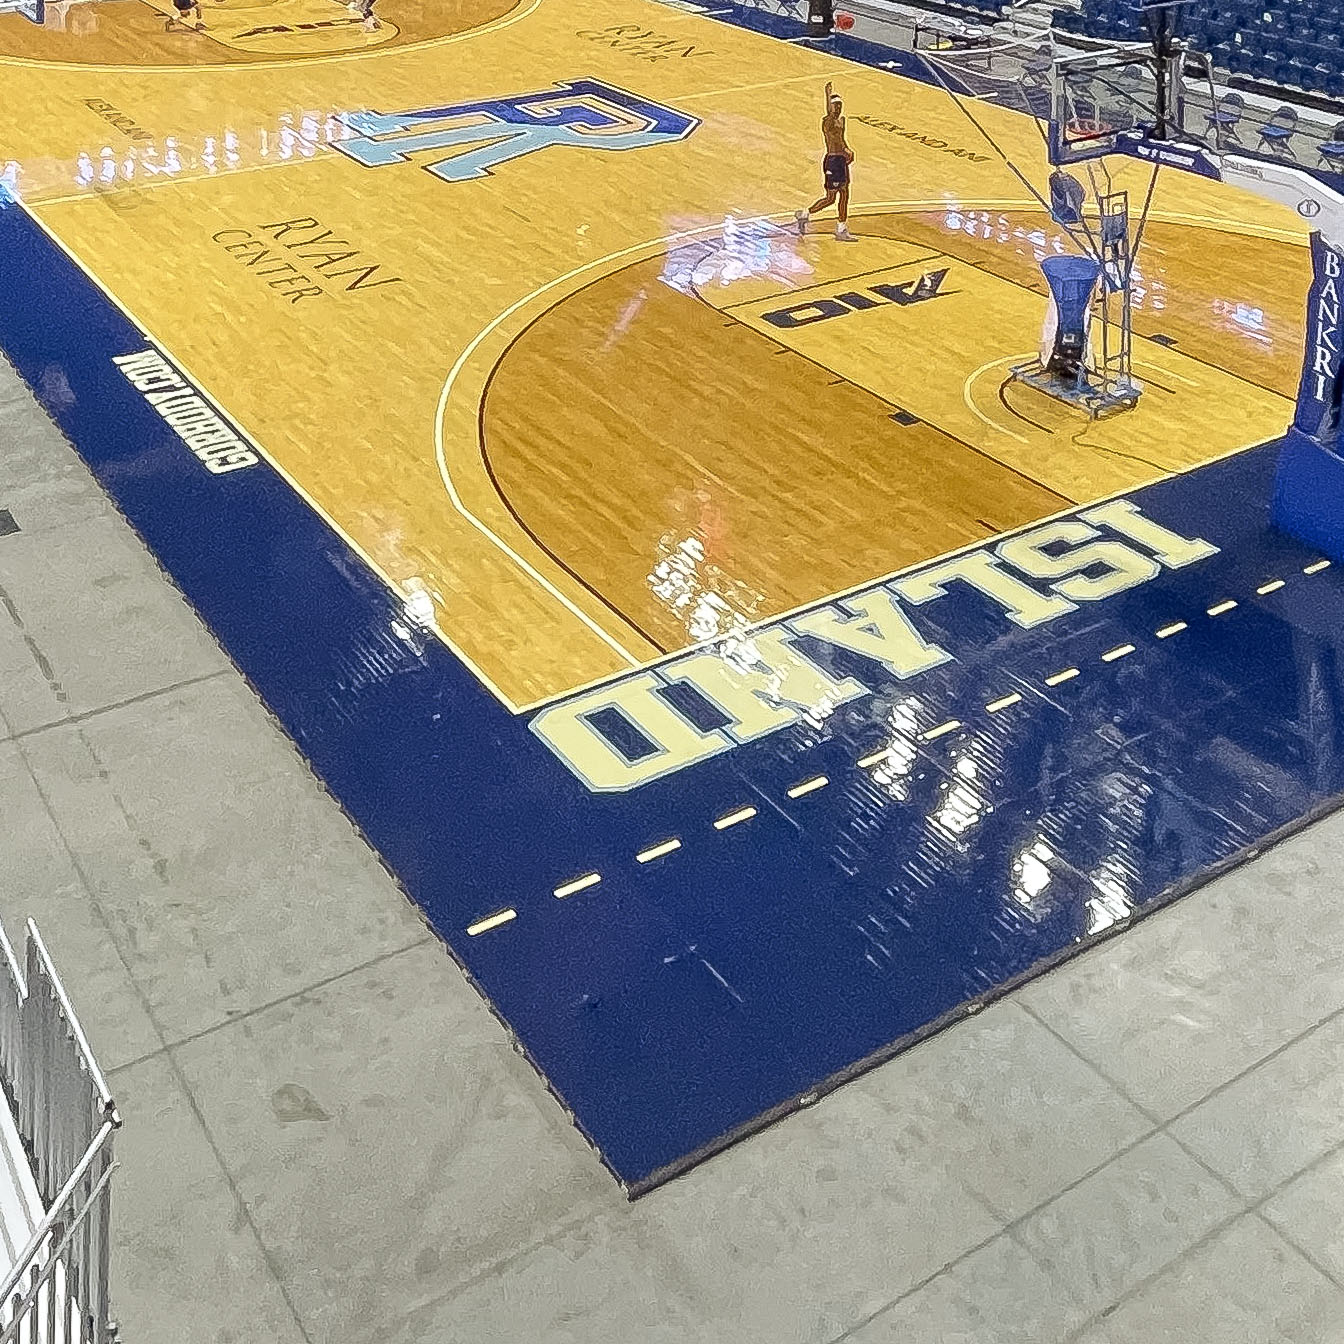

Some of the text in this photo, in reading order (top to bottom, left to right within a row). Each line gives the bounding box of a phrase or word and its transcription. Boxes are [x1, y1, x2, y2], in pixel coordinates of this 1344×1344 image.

[212, 229, 323, 304] CENTER
[257, 216, 404, 292] RYAN
[527, 498, 1221, 794] ISLAND
